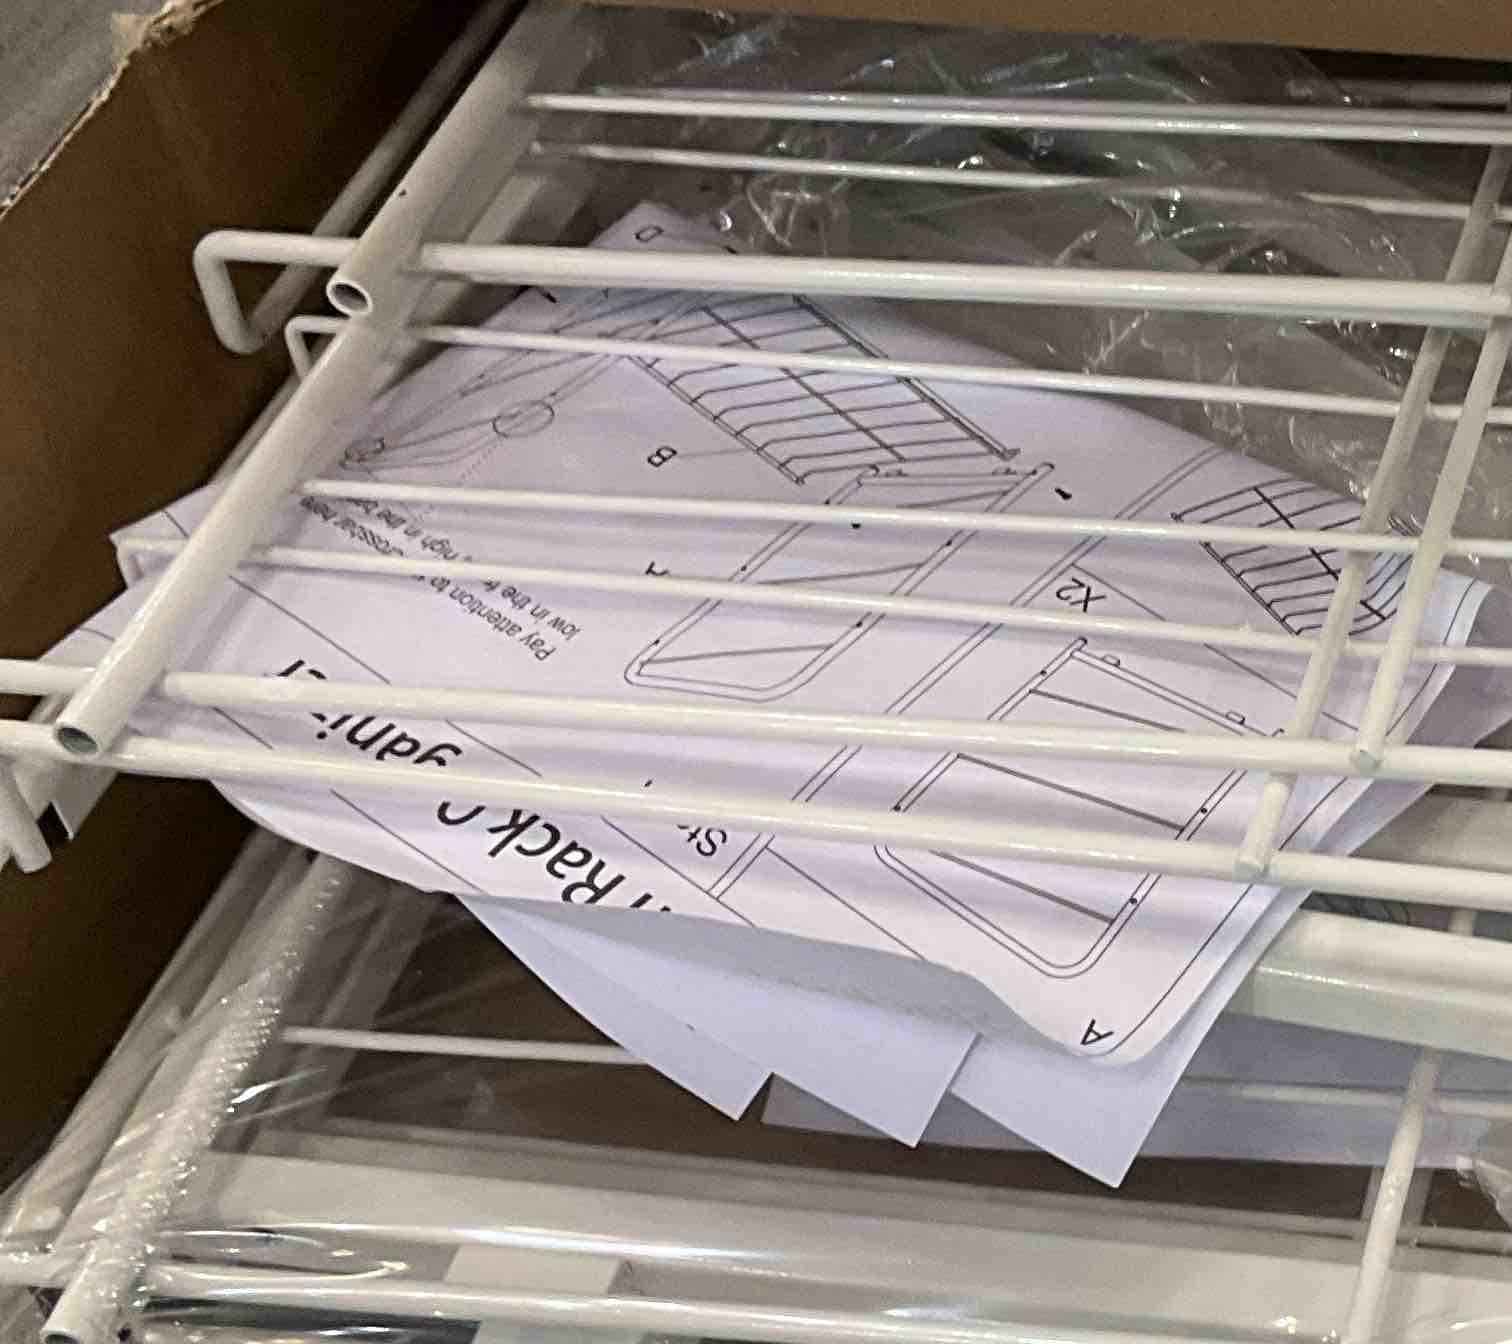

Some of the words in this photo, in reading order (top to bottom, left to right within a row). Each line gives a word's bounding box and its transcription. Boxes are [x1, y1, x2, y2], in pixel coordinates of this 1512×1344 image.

[647, 445, 678, 468] B
[449, 585, 524, 636] attention
[1055, 577, 1108, 613] X2
[521, 631, 559, 662] Pay
[487, 808, 626, 905] Rack
[1081, 1018, 1115, 1046] A
